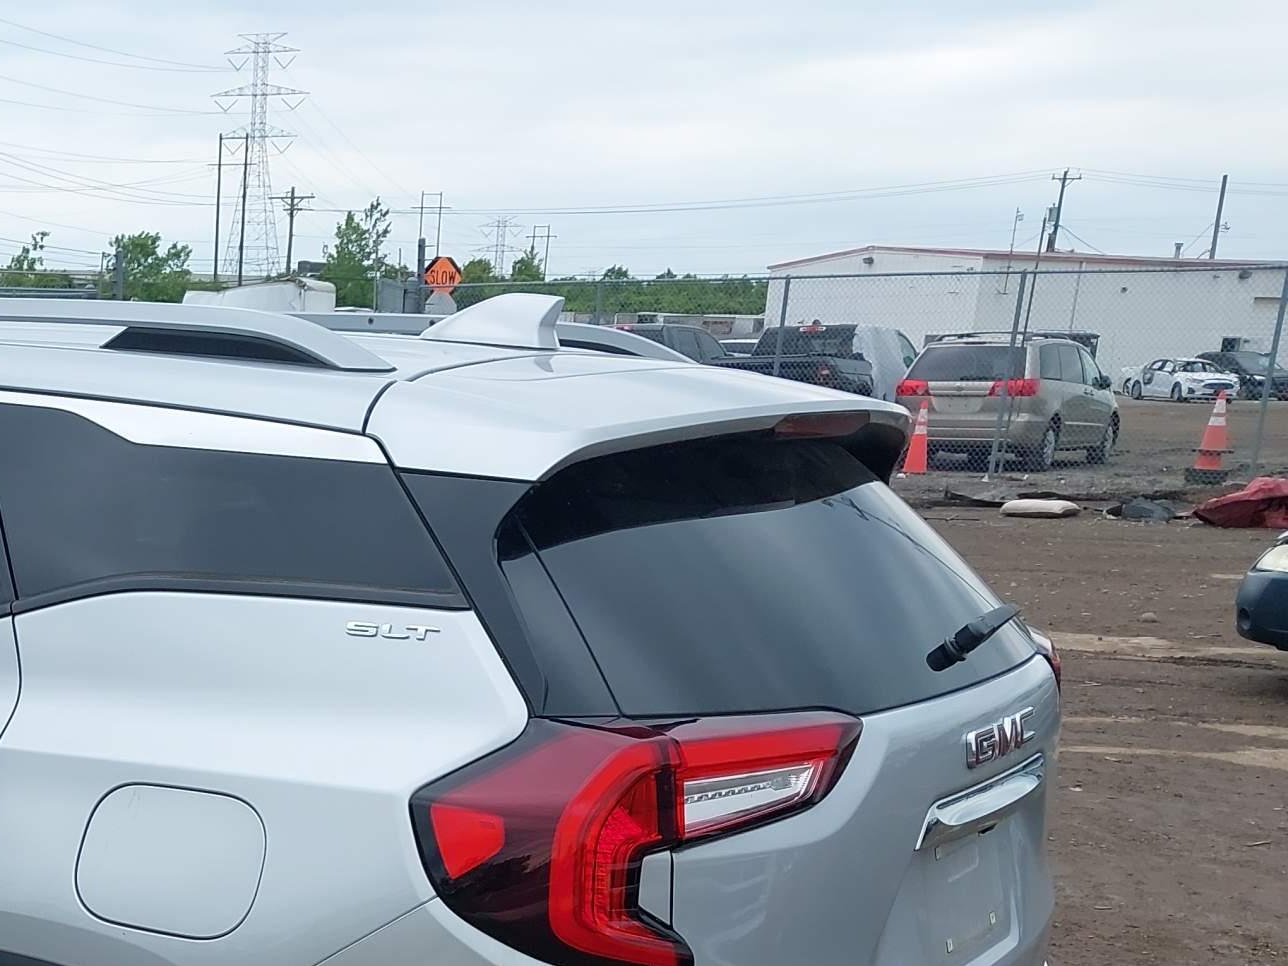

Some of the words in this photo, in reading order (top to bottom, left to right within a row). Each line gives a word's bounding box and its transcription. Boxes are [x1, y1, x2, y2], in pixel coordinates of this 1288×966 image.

[430, 270, 456, 285] SLOW
[345, 621, 440, 641] SLT
[965, 706, 1035, 768] GMC
